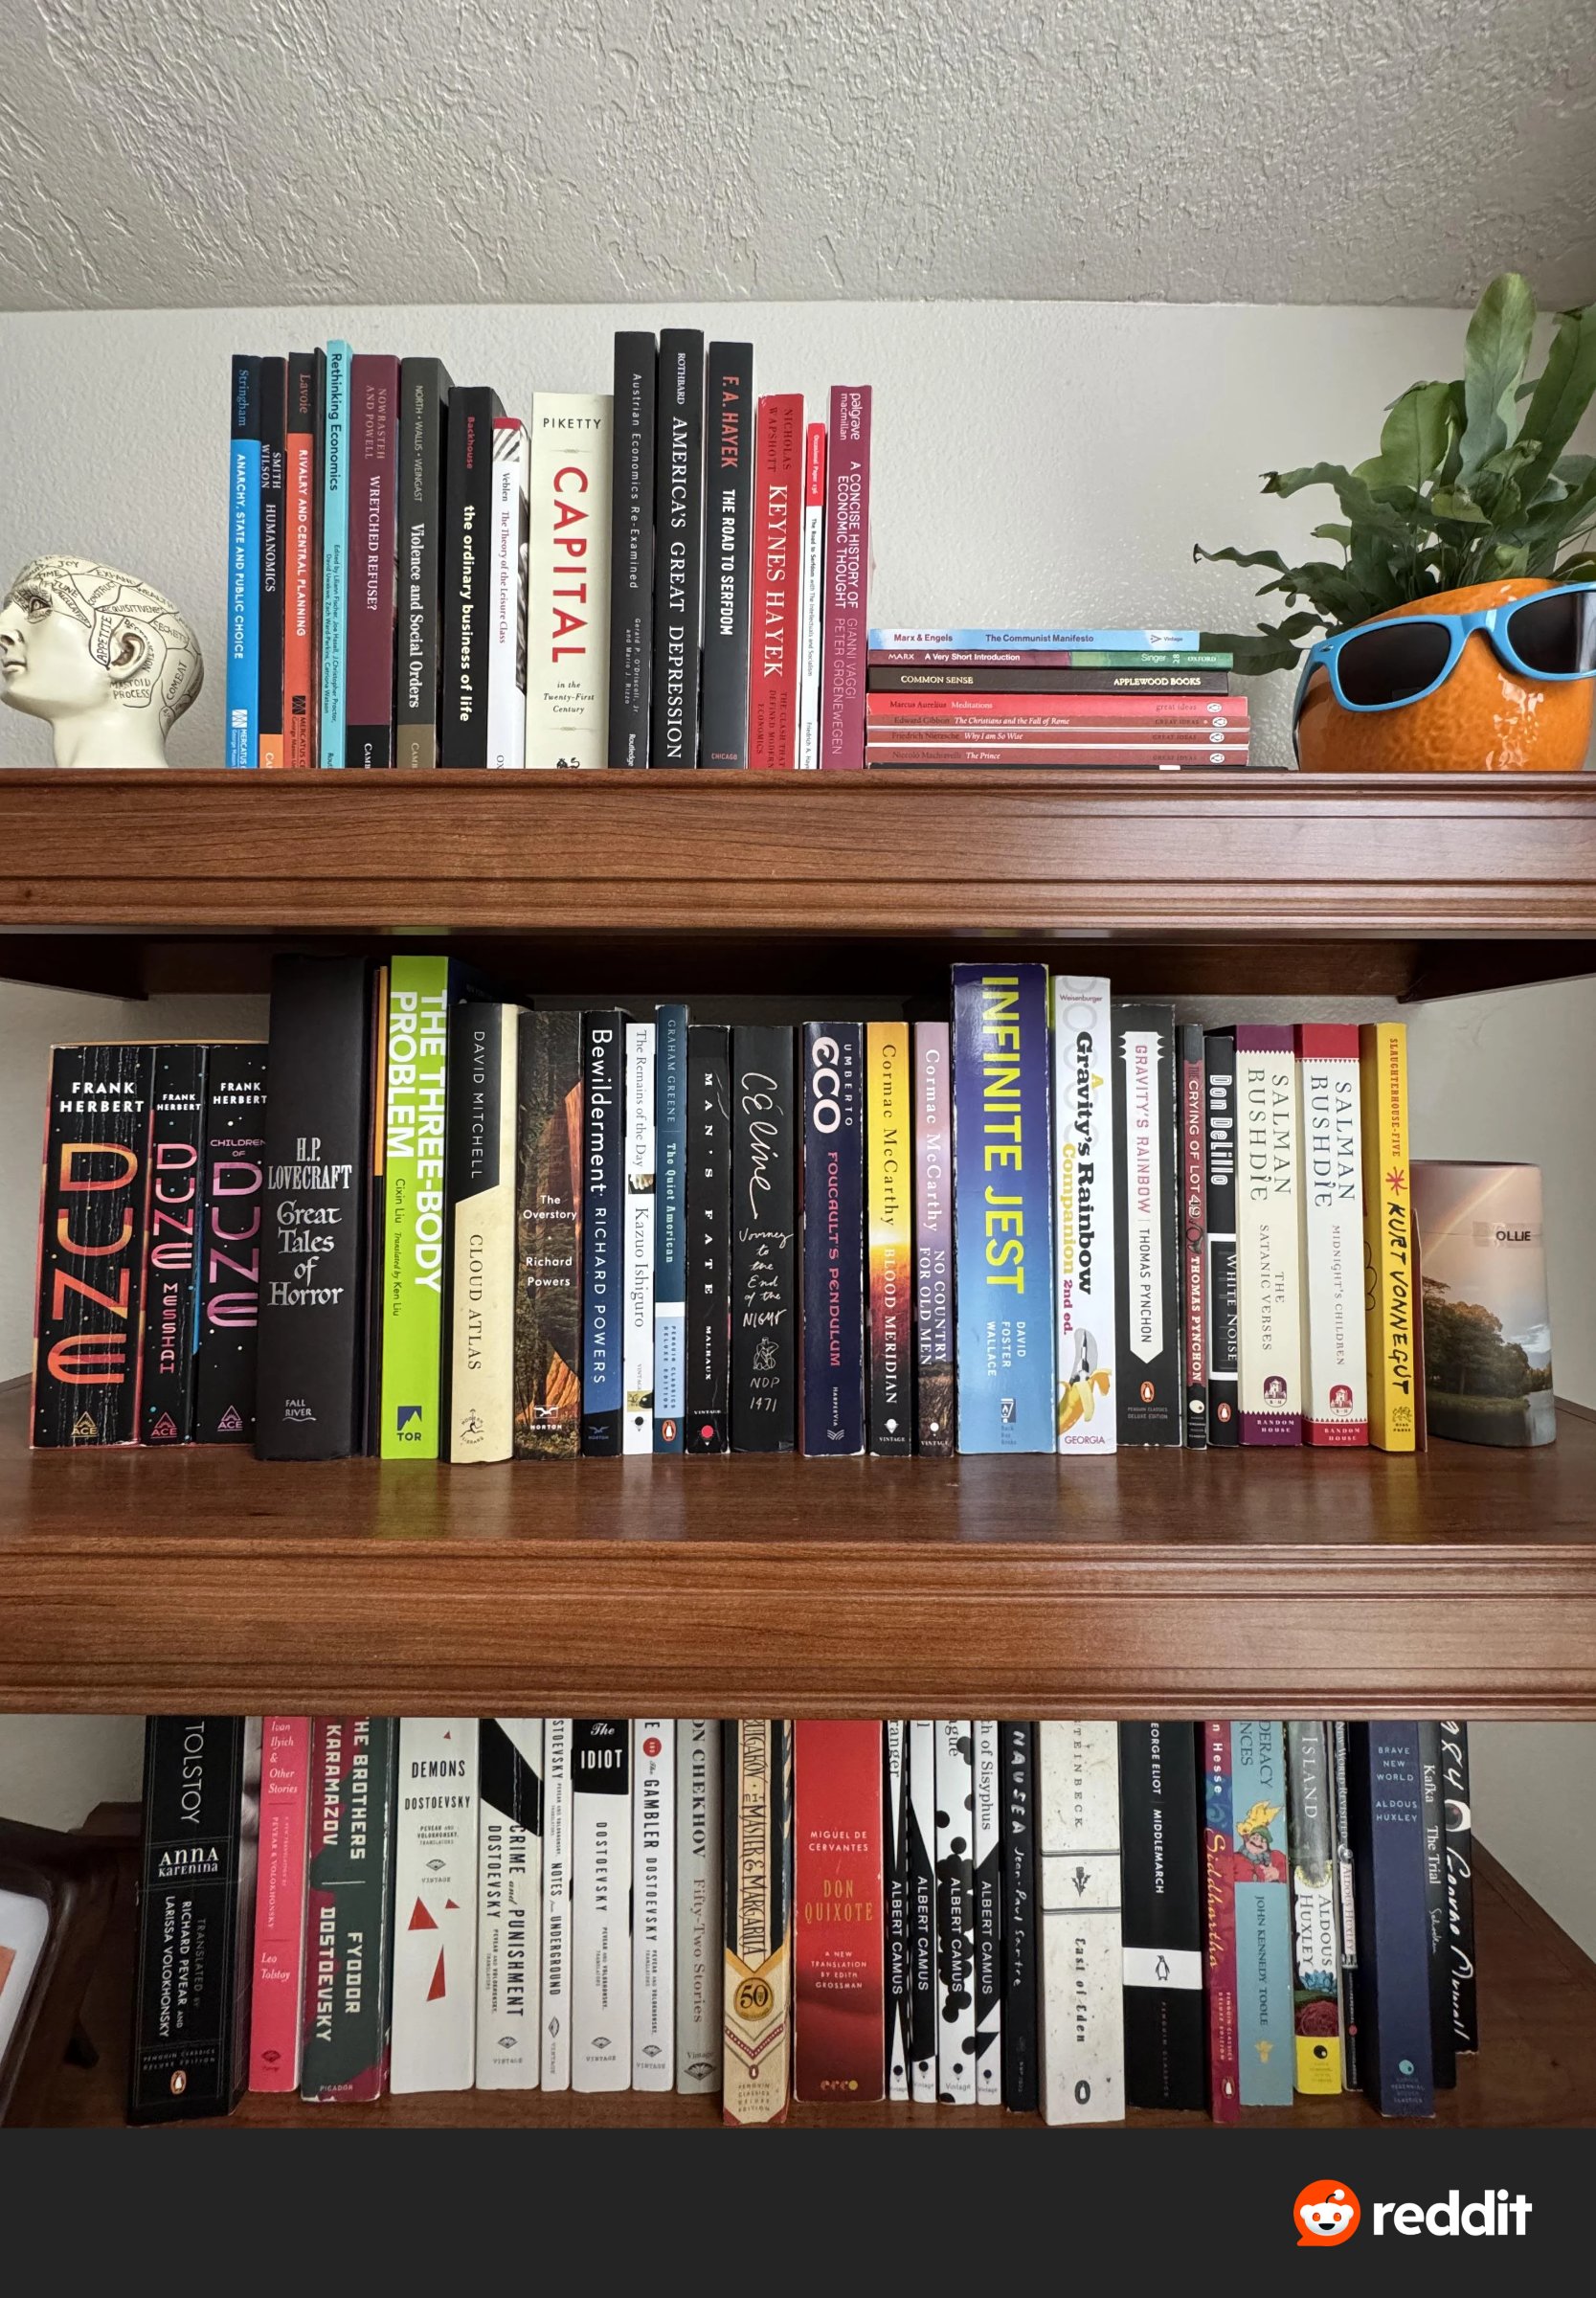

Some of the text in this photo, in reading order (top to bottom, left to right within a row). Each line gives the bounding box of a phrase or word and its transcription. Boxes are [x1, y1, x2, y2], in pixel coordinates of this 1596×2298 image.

[677, 352, 686, 405] ROTHBARD
[328, 352, 343, 491] Rethinking Economics
[543, 417, 601, 430] PIKETTY
[839, 393, 847, 441] macmillan
[848, 393, 862, 440] palgrave
[260, 443, 270, 489] WILSON
[272, 451, 281, 490] SMITH
[629, 372, 642, 589] Austrian Economics Re-Examined
[234, 454, 247, 660] ANARCHY, STATE AND PUBLIC CHOICE
[264, 504, 277, 593] HUMANOMICS
[296, 448, 308, 637] RIVALRY AND CENTRAL PLANNING
[552, 466, 589, 663] CAPITAL
[720, 489, 735, 636] THE ROAD TO SERFDOM
[835, 476, 849, 609] ECONOMIC THOUGHT
[847, 462, 862, 608] A CONCISE HISTORY OF
[669, 541, 686, 613] GREAT
[96, 614, 113, 663] APPETITE
[409, 523, 425, 709] Violence and Social Orders
[460, 505, 476, 722] the ordinary business of life
[893, 634, 914, 642] Marx
[925, 634, 953, 643] Engels
[900, 675, 974, 685] COMMON SENSE
[933, 653, 950, 662] Very
[1140, 653, 1166, 663] Singer
[113, 689, 150, 700] PROCESS
[552, 705, 585, 714] Century
[666, 625, 684, 758] DEPRESSION
[1059, 994, 1103, 1003] Weisenburger
[59, 1101, 145, 1114] HERBERT
[72, 1082, 136, 1094] FRANK
[386, 991, 417, 1159] PROBLEM
[471, 1031, 485, 1179] DAVID MITCHELL
[633, 1029, 647, 1168] The Remains of the Day
[843, 1044, 853, 1126] UMBERTO
[982, 977, 1024, 1295] INFINITE JEST
[1310, 1074, 1337, 1207] RUSHDIE
[1334, 1081, 1356, 1201] SALMAN
[268, 1164, 353, 1190] LOVECRAFT
[540, 1194, 561, 1205] The
[1135, 1136, 1151, 1214] RAINBOW
[277, 1200, 343, 1227] Great
[278, 1227, 335, 1254] Tales
[523, 1209, 577, 1221] Overstory
[881, 1044, 898, 1404] Cormac McCarthy BLOOD MERIDIAN
[1495, 1229, 1532, 1243] OLLIE
[48, 1142, 139, 1385] DUNE
[294, 1256, 321, 1287] of
[390, 1231, 403, 1317] Translated by Ken Liu
[630, 1207, 649, 1328] Kazuo Ishiguro
[1138, 1228, 1151, 1278] THOMAS
[267, 1281, 345, 1306] Horror
[467, 1233, 483, 1370] CLOUD ATLAS
[1139, 1284, 1152, 1343] PYNCHON
[1226, 1253, 1237, 1362] WHITE NOISE
[1385, 1201, 1410, 1395] KURT VONNEGUT
[986, 1320, 997, 1377] WALLACE
[1000, 1320, 1011, 1369] FOSTER
[1016, 1320, 1025, 1358] DAVID
[1334, 1303, 1344, 1365] CHILDREN
[285, 1399, 306, 1408] FALL
[285, 1408, 312, 1417] RIVER
[396, 1431, 422, 1441] TOR
[1064, 1434, 1105, 1445] GEORGIA
[181, 1721, 206, 1825] TOLSTOY
[412, 1760, 466, 1779] DEMONS
[580, 1748, 623, 1770] IDIOT
[1302, 1736, 1319, 1819] ISLAND
[1376, 1773, 1414, 1782] WORLD
[1378, 1746, 1411, 1755] BRAVE
[1382, 1760, 1406, 1769] NEW
[323, 1724, 342, 1846] KARAMAZOV
[350, 1753, 369, 1859] BROTHERS
[1152, 1763, 1165, 1895] ELIOT MIDDLEMARCH
[1423, 1764, 1441, 1885] Kafka The Trial
[643, 1780, 661, 1942] GAMBLER DOSTOEVSKY
[690, 1748, 706, 2023] CHEKHOV Fifty-Two Stories
[823, 1879, 854, 1899] DON
[506, 1824, 527, 2017] CRIME and PUNISHMENT
[804, 1902, 873, 1924] QUIXOTE
[891, 1880, 903, 1994] ALBERT CAMUS
[981, 1881, 993, 1994] ALBERT CAMUS
[260, 1952, 278, 1964] Leo
[260, 1968, 291, 1982] Tolstoy
[316, 1906, 336, 2042] DOSTOEVSKY
[345, 1932, 363, 2014] FYODOR
[549, 1915, 562, 1995] UNDERGROUND
[1255, 1895, 1269, 2026] JOHN KENNEDY TOOLE
